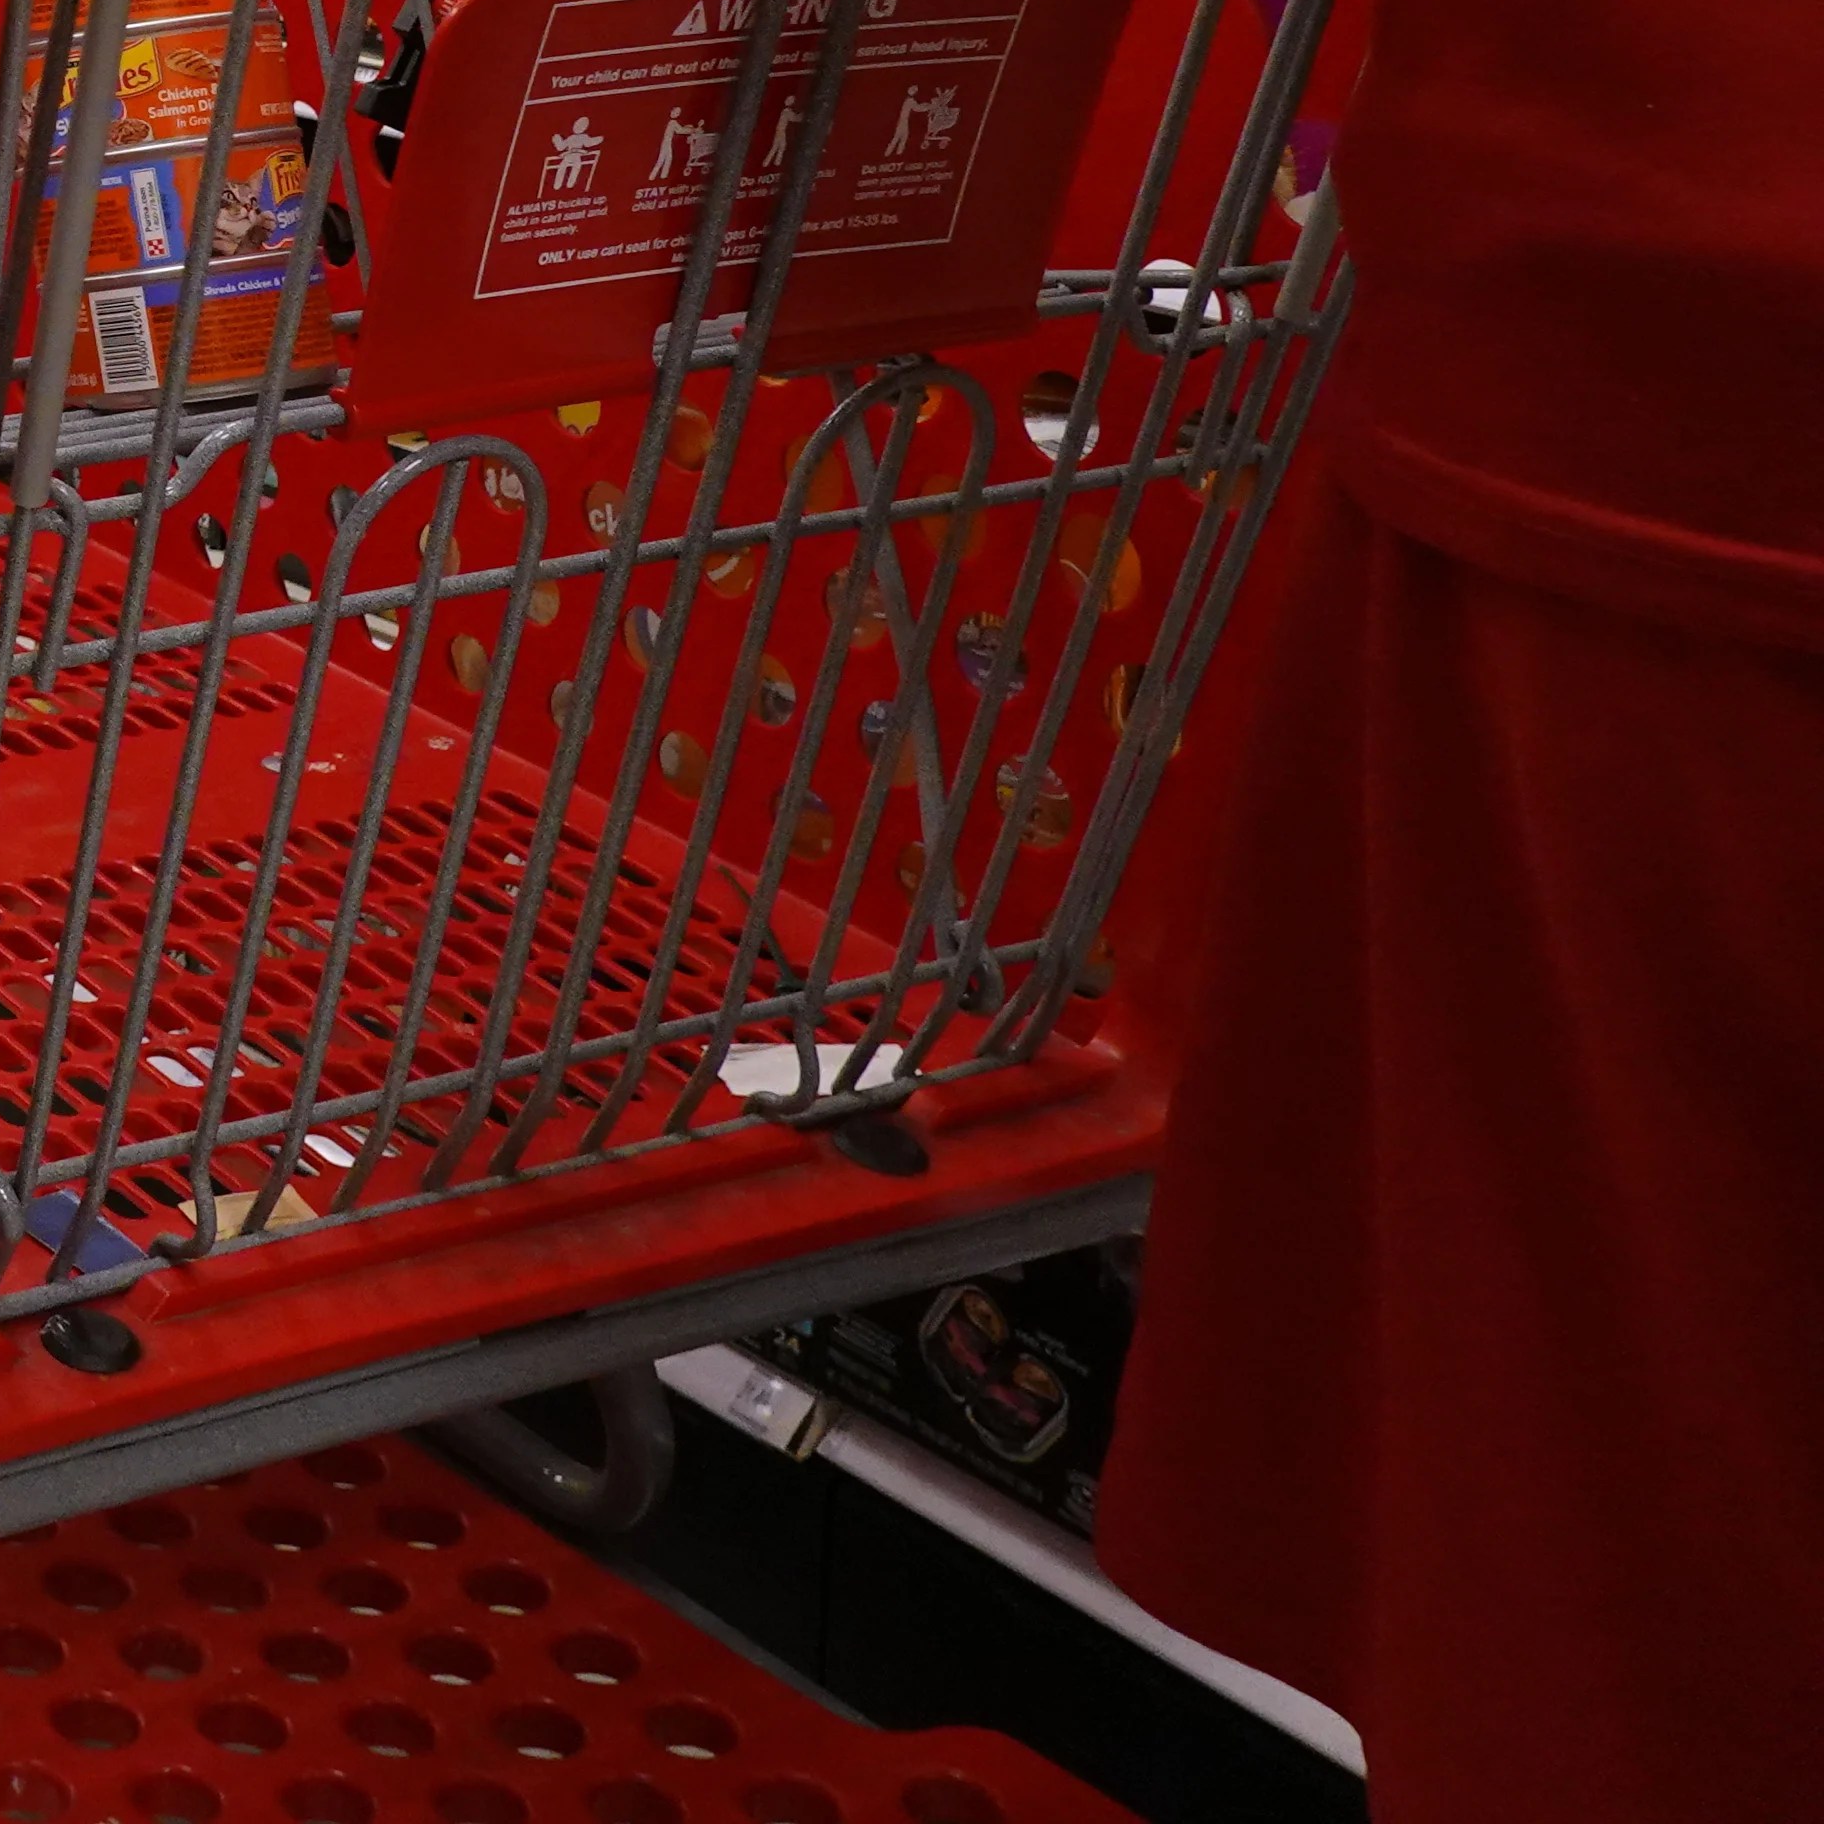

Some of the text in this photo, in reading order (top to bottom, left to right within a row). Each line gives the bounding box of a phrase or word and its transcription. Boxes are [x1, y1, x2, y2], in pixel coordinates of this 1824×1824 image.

[551, 73, 583, 89] Your
[585, 69, 619, 85] child
[621, 66, 648, 81] can
[650, 63, 673, 79] fall
[674, 61, 699, 74] out
[700, 58, 715, 72] of
[855, 42, 908, 58] serious
[910, 40, 944, 53] head
[945, 36, 989, 52] injury.
[157, 87, 208, 103] Chicken
[147, 103, 195, 120] Salmon
[878, 162, 904, 174] NOT
[634, 186, 667, 200] STAY
[507, 199, 557, 217] ALWAYS
[557, 196, 592, 210] buckle
[631, 199, 658, 213] child
[503, 215, 532, 230] child
[533, 215, 545, 226] in
[545, 212, 563, 224] cart
[563, 210, 585, 223] seat
[500, 229, 532, 243] fasten
[538, 248, 575, 266] ONLY
[576, 247, 599, 261] use
[599, 243, 625, 258] cart
[625, 241, 651, 254] seat
[652, 238, 669, 251] for
[723, 229, 746, 242] ges
[203, 282, 237, 297] Shreds
[237, 278, 272, 294] Chicken
